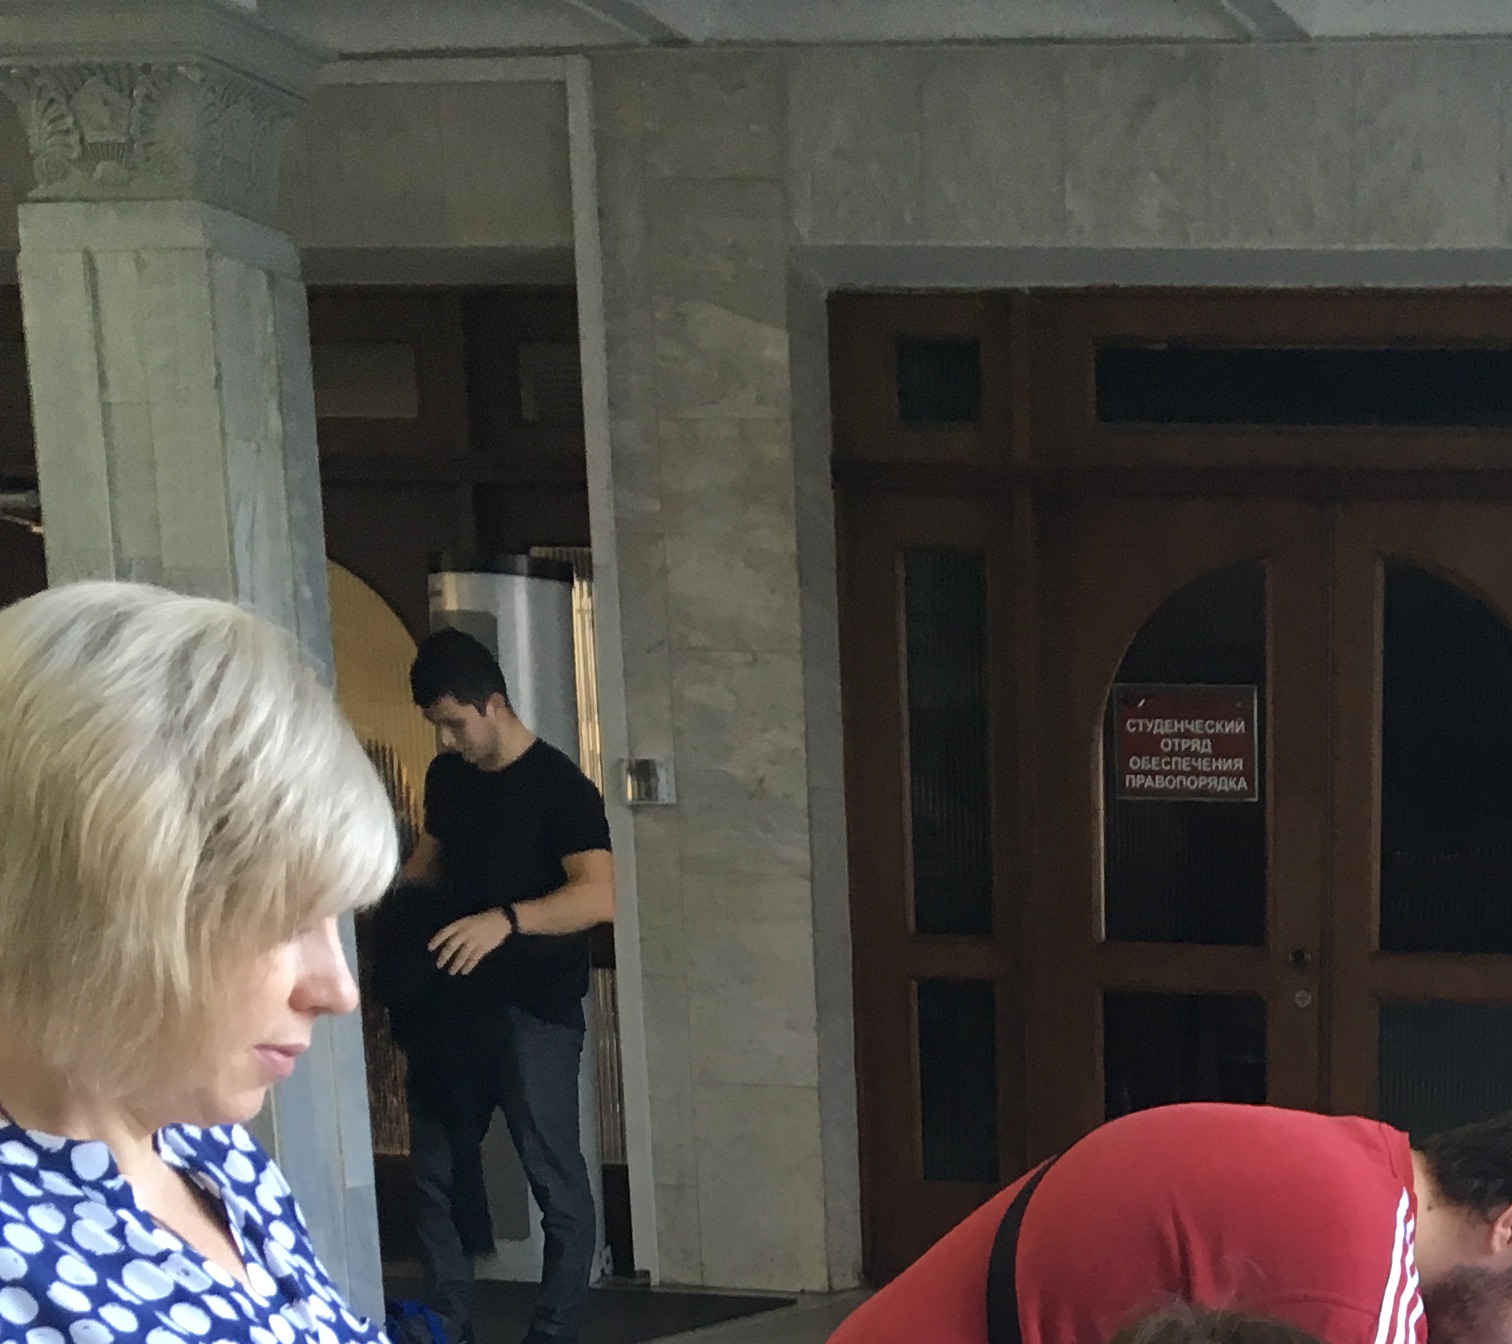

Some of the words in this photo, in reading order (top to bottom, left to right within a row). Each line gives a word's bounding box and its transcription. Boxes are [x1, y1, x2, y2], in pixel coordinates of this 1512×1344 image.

[1126, 717, 1246, 735] СТУДЕНЧЕСКИЙ
[1160, 738, 1213, 754] ОТРЯД
[1129, 756, 1244, 771] ОБЕСПЕЧЕНИЯ
[1125, 774, 1248, 791] ПРАВОПОРЯДКА
